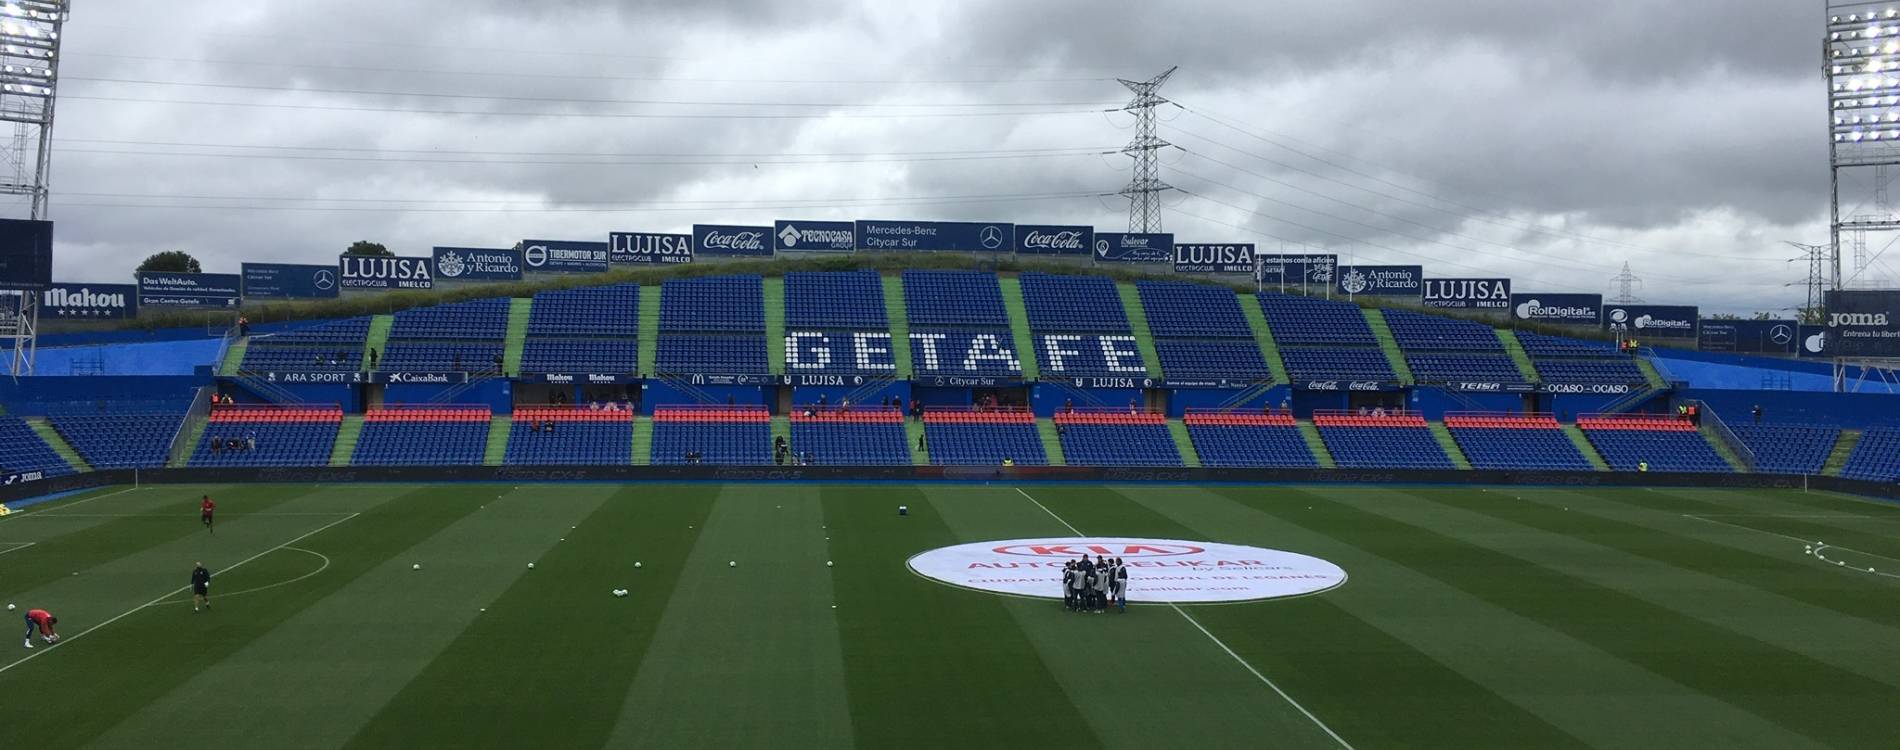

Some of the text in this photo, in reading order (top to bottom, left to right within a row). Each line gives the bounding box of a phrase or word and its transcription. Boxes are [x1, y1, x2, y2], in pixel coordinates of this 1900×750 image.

[866, 224, 937, 235] Mercedes-Benz
[703, 230, 765, 250] Coca-Cola
[801, 230, 853, 243] TECNOCASA
[1023, 230, 1084, 250] Coca-Cola
[1121, 234, 1149, 246] Bulevar
[611, 234, 691, 255] LUJISA
[866, 237, 918, 248] Citycar Sur
[466, 252, 514, 263] Antonio
[549, 249, 592, 261] TIBERMOTOR
[593, 251, 607, 261] SUR
[611, 254, 652, 262] ELECTROCLUB
[1175, 245, 1253, 264] LUJISA
[342, 257, 431, 280] LUJISA
[466, 262, 519, 275] y Ricardo
[1175, 264, 1215, 272] ELECTROCLUB
[1368, 269, 1412, 279] Antonio
[143, 276, 159, 286] Das
[342, 279, 431, 289] ELECTROCLUB IMELCO
[1368, 278, 1418, 291] y Ricardo
[1424, 280, 1508, 300] LUJISA
[44, 287, 126, 308] Mahou
[1424, 299, 1467, 308] ELECTROCLUB
[1843, 330, 1872, 338] Entrena
[785, 330, 1147, 372] GETAFE
[284, 373, 346, 382] ARA SPORT
[402, 372, 449, 382] CaixaBank
[546, 373, 574, 381] Mahou
[588, 373, 616, 381] Mahou
[801, 375, 845, 386] LUJISA
[949, 376, 996, 387] Citycar Sur
[1092, 378, 1135, 388] LUJISA
[1308, 380, 1339, 390] Coca-Cola
[1349, 380, 1379, 391] Coca-Cola
[1459, 382, 1501, 391] TEISA
[1548, 384, 1629, 394] OCASO OCASO
[1030, 545, 1177, 555] KIA
[1124, 560, 1266, 568] ELIKAR
